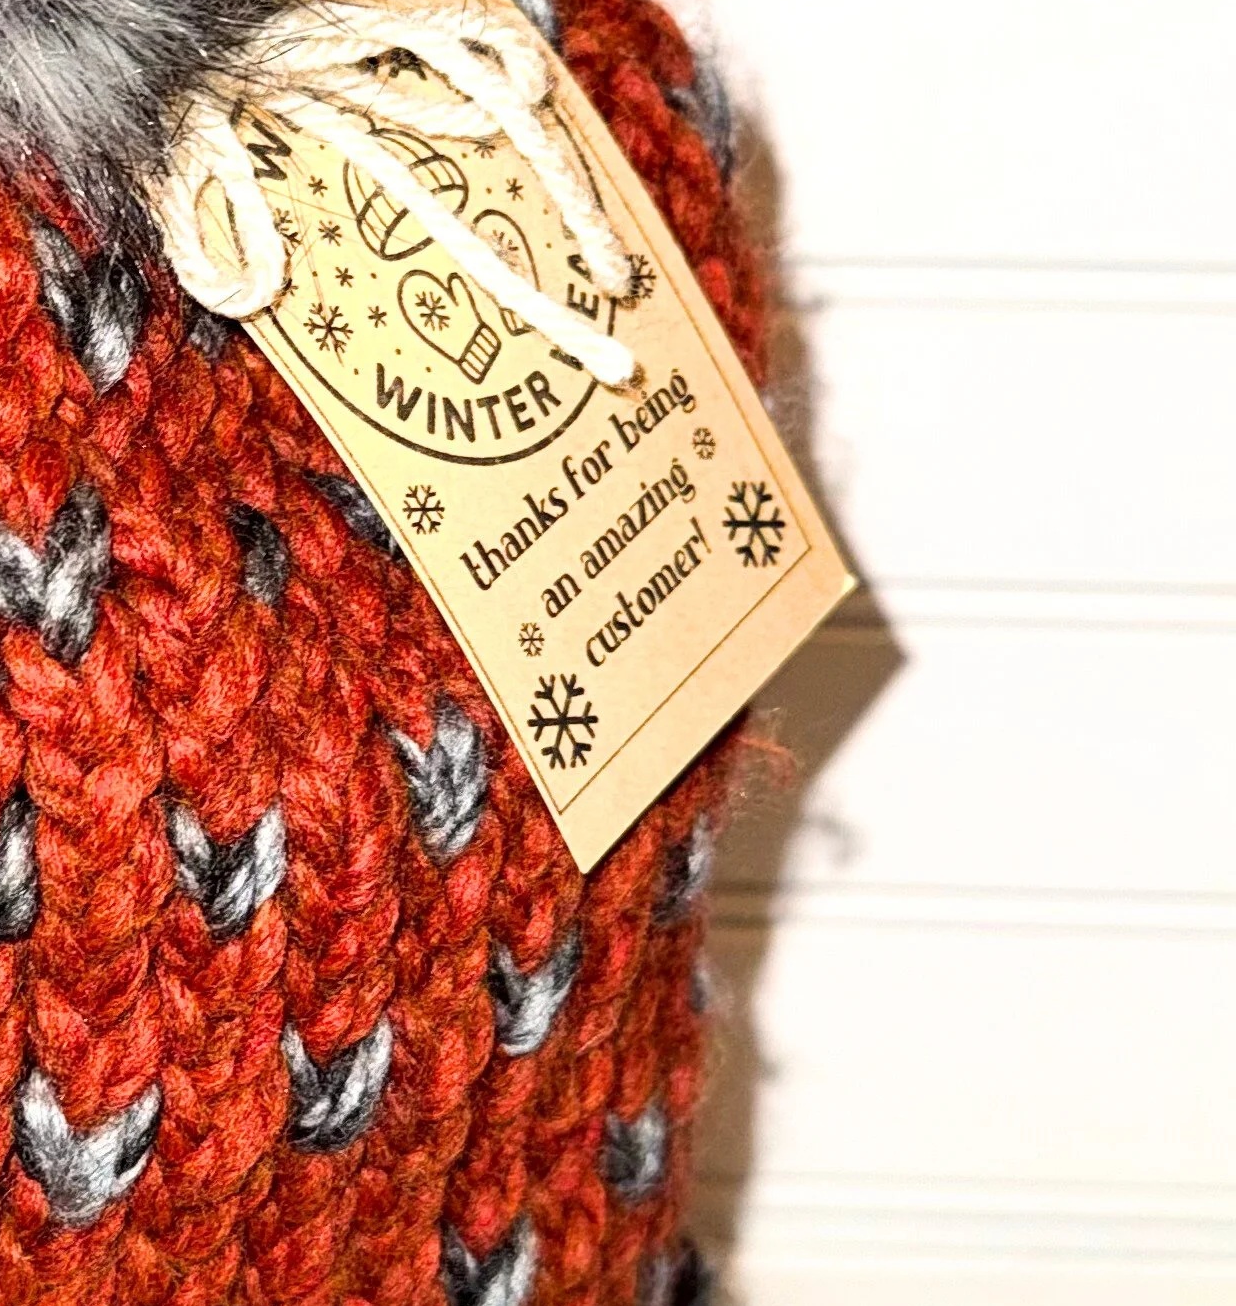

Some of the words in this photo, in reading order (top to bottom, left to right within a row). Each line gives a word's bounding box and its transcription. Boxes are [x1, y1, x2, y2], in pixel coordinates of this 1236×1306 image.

[376, 362, 562, 443] WINTER
[459, 486, 569, 591] thanks
[561, 439, 613, 500] for
[608, 368, 696, 454] being
[540, 573, 582, 618] an
[579, 458, 696, 579] amazing
[585, 516, 712, 667] customer!
